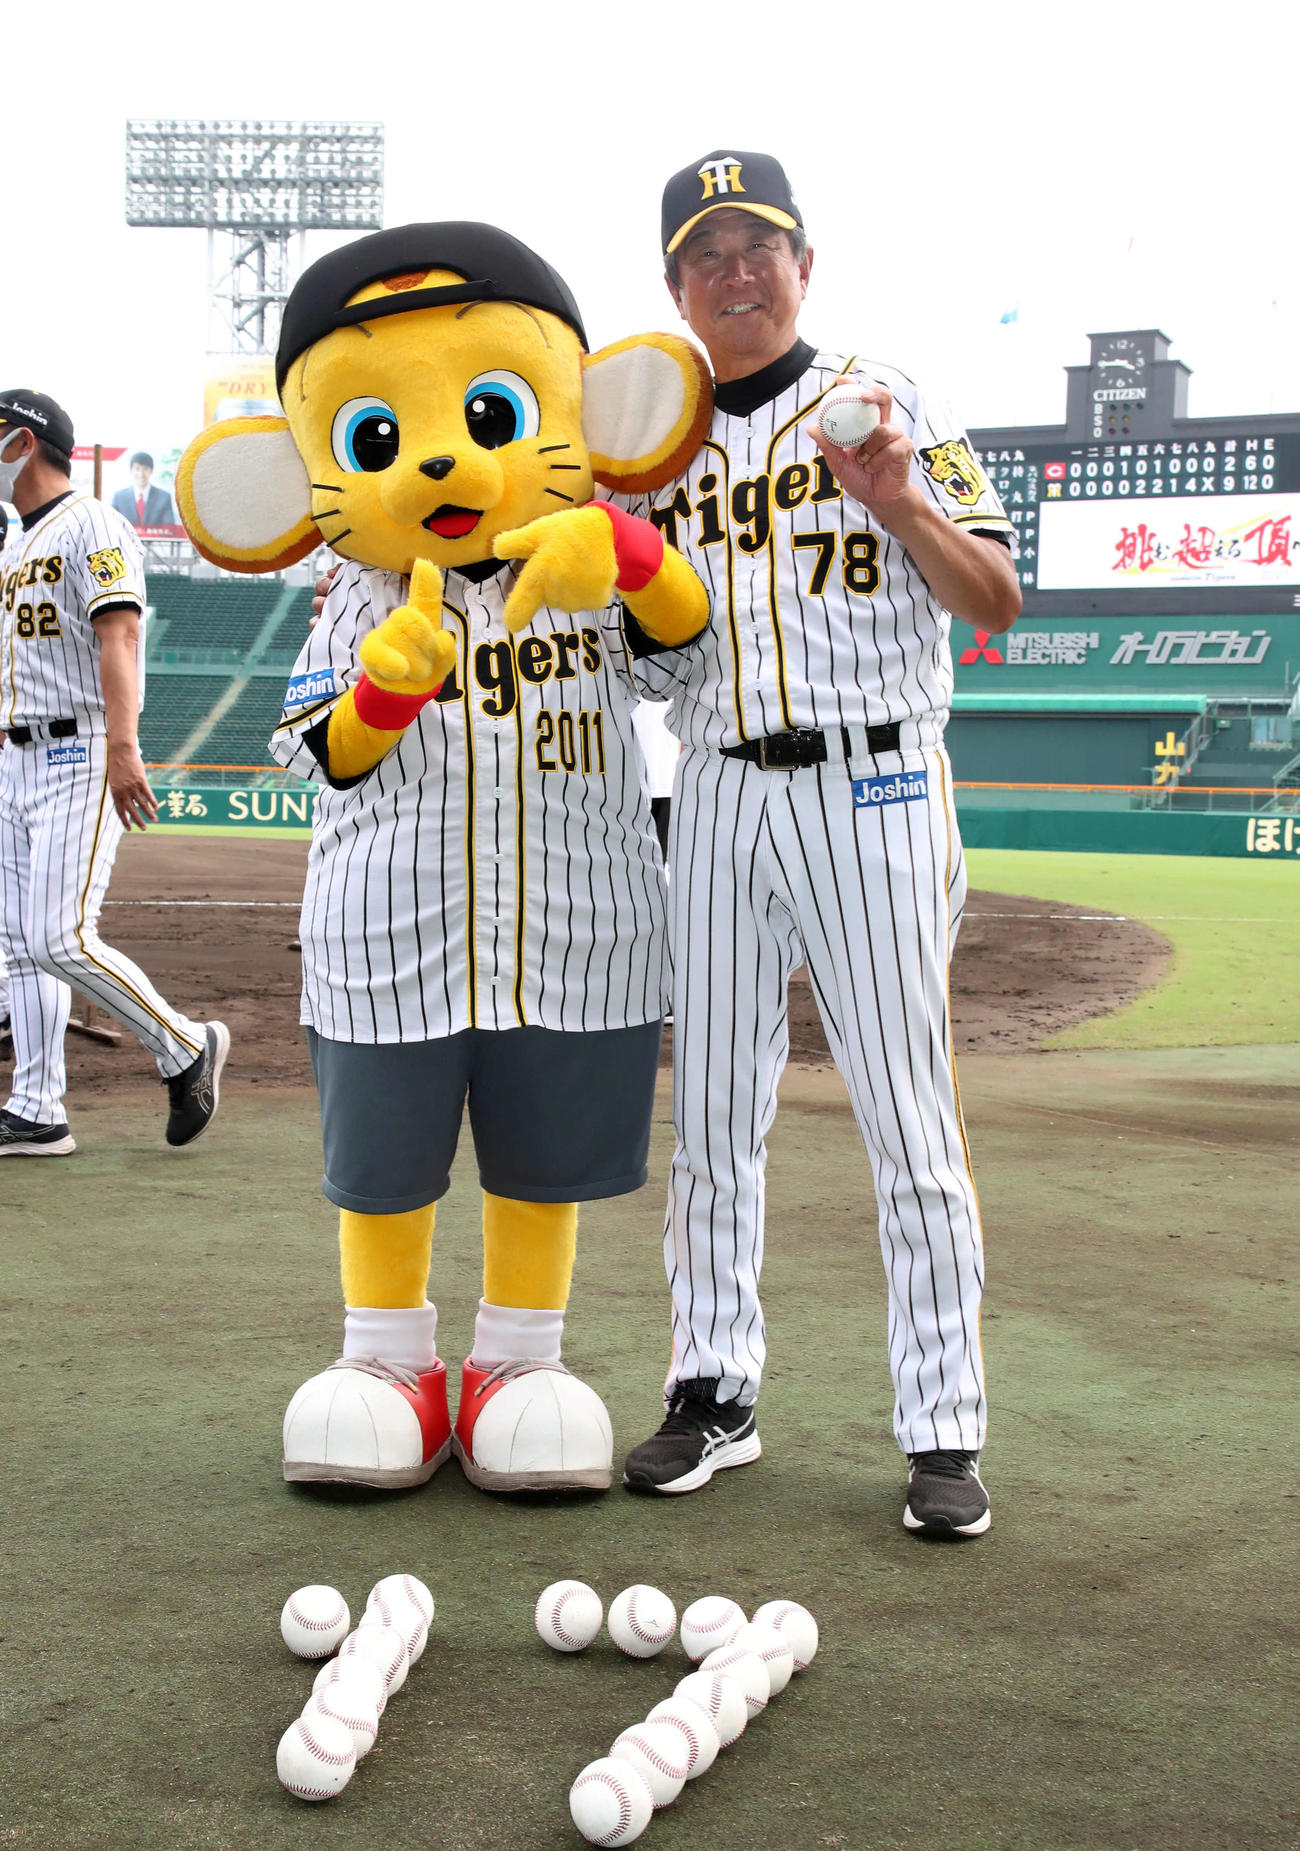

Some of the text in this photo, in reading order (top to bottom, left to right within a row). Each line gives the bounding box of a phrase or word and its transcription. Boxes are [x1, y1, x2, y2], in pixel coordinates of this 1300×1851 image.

[1093, 387, 1147, 402] CITIZEN
[650, 454, 844, 556] Tiger
[791, 529, 881, 597] 78
[17, 602, 62, 639] 82
[1007, 632, 1100, 649] MITSUBISHI
[1006, 649, 1087, 665] ELECTRIC
[286, 674, 334, 702] oshin
[534, 708, 607, 776] 2011
[48, 749, 86, 764] Joshin
[855, 775, 928, 804] Joshin
